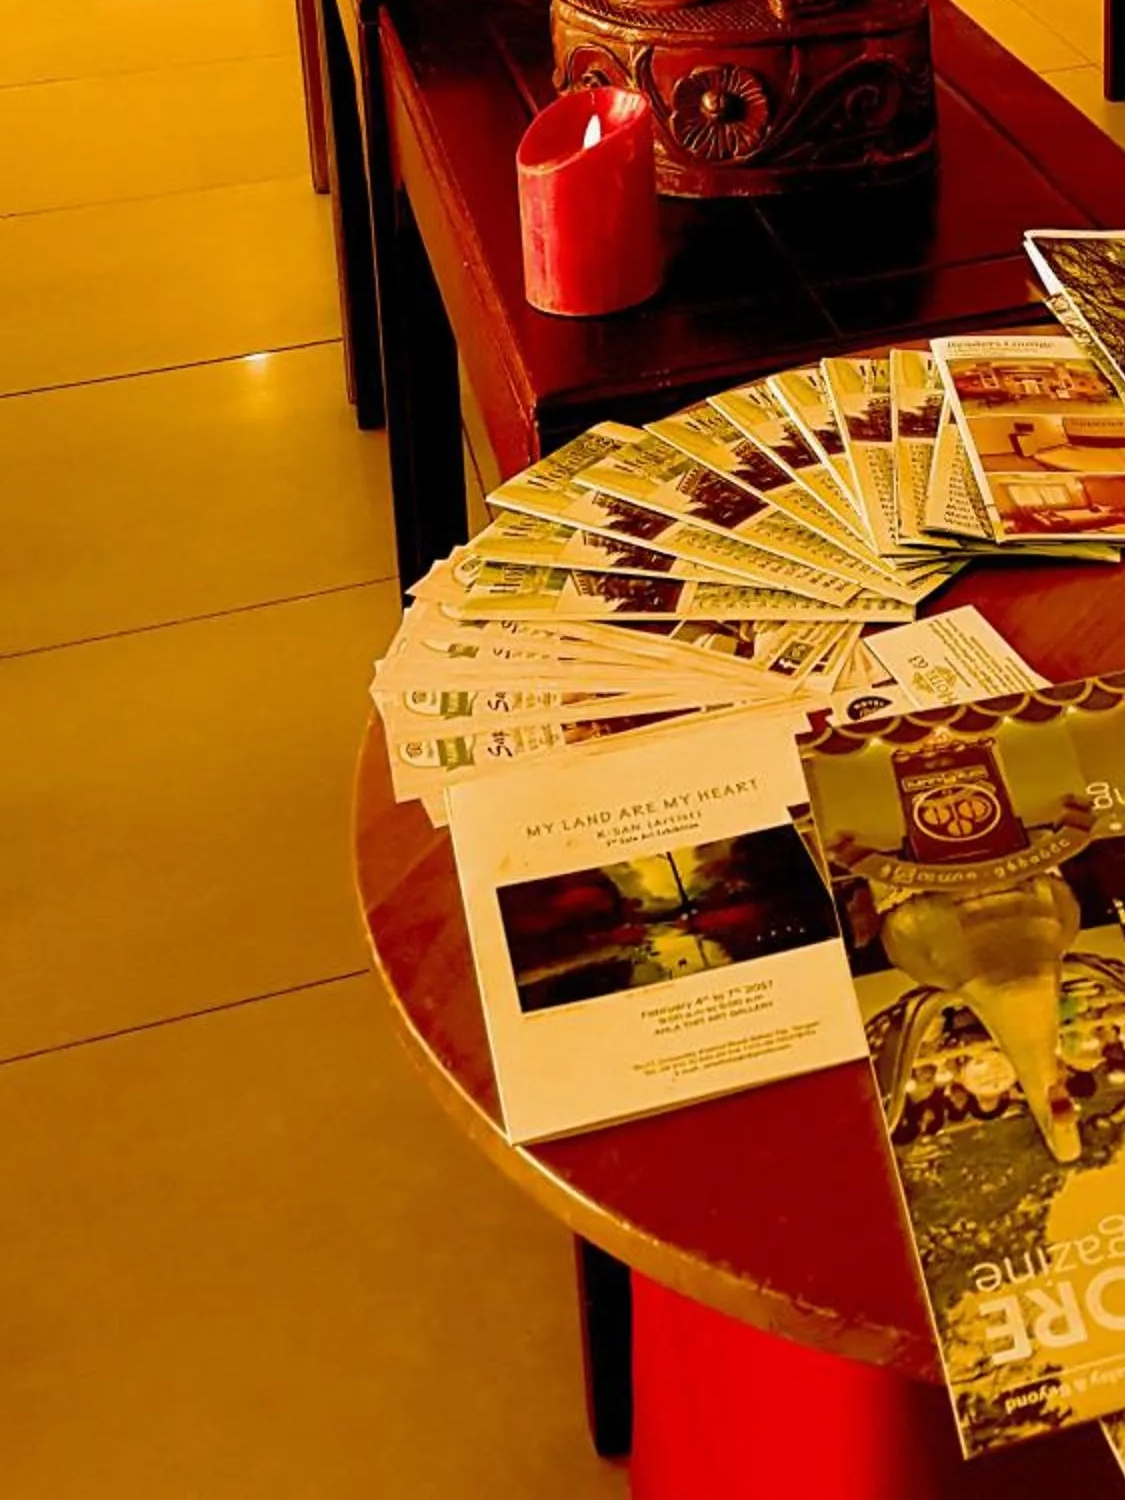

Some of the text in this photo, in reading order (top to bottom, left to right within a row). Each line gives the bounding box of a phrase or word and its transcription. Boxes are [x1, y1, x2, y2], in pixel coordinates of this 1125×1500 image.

[526, 779, 759, 839] MY LAND ARE MY HEART
[1004, 1381, 1070, 1413] Beyond
